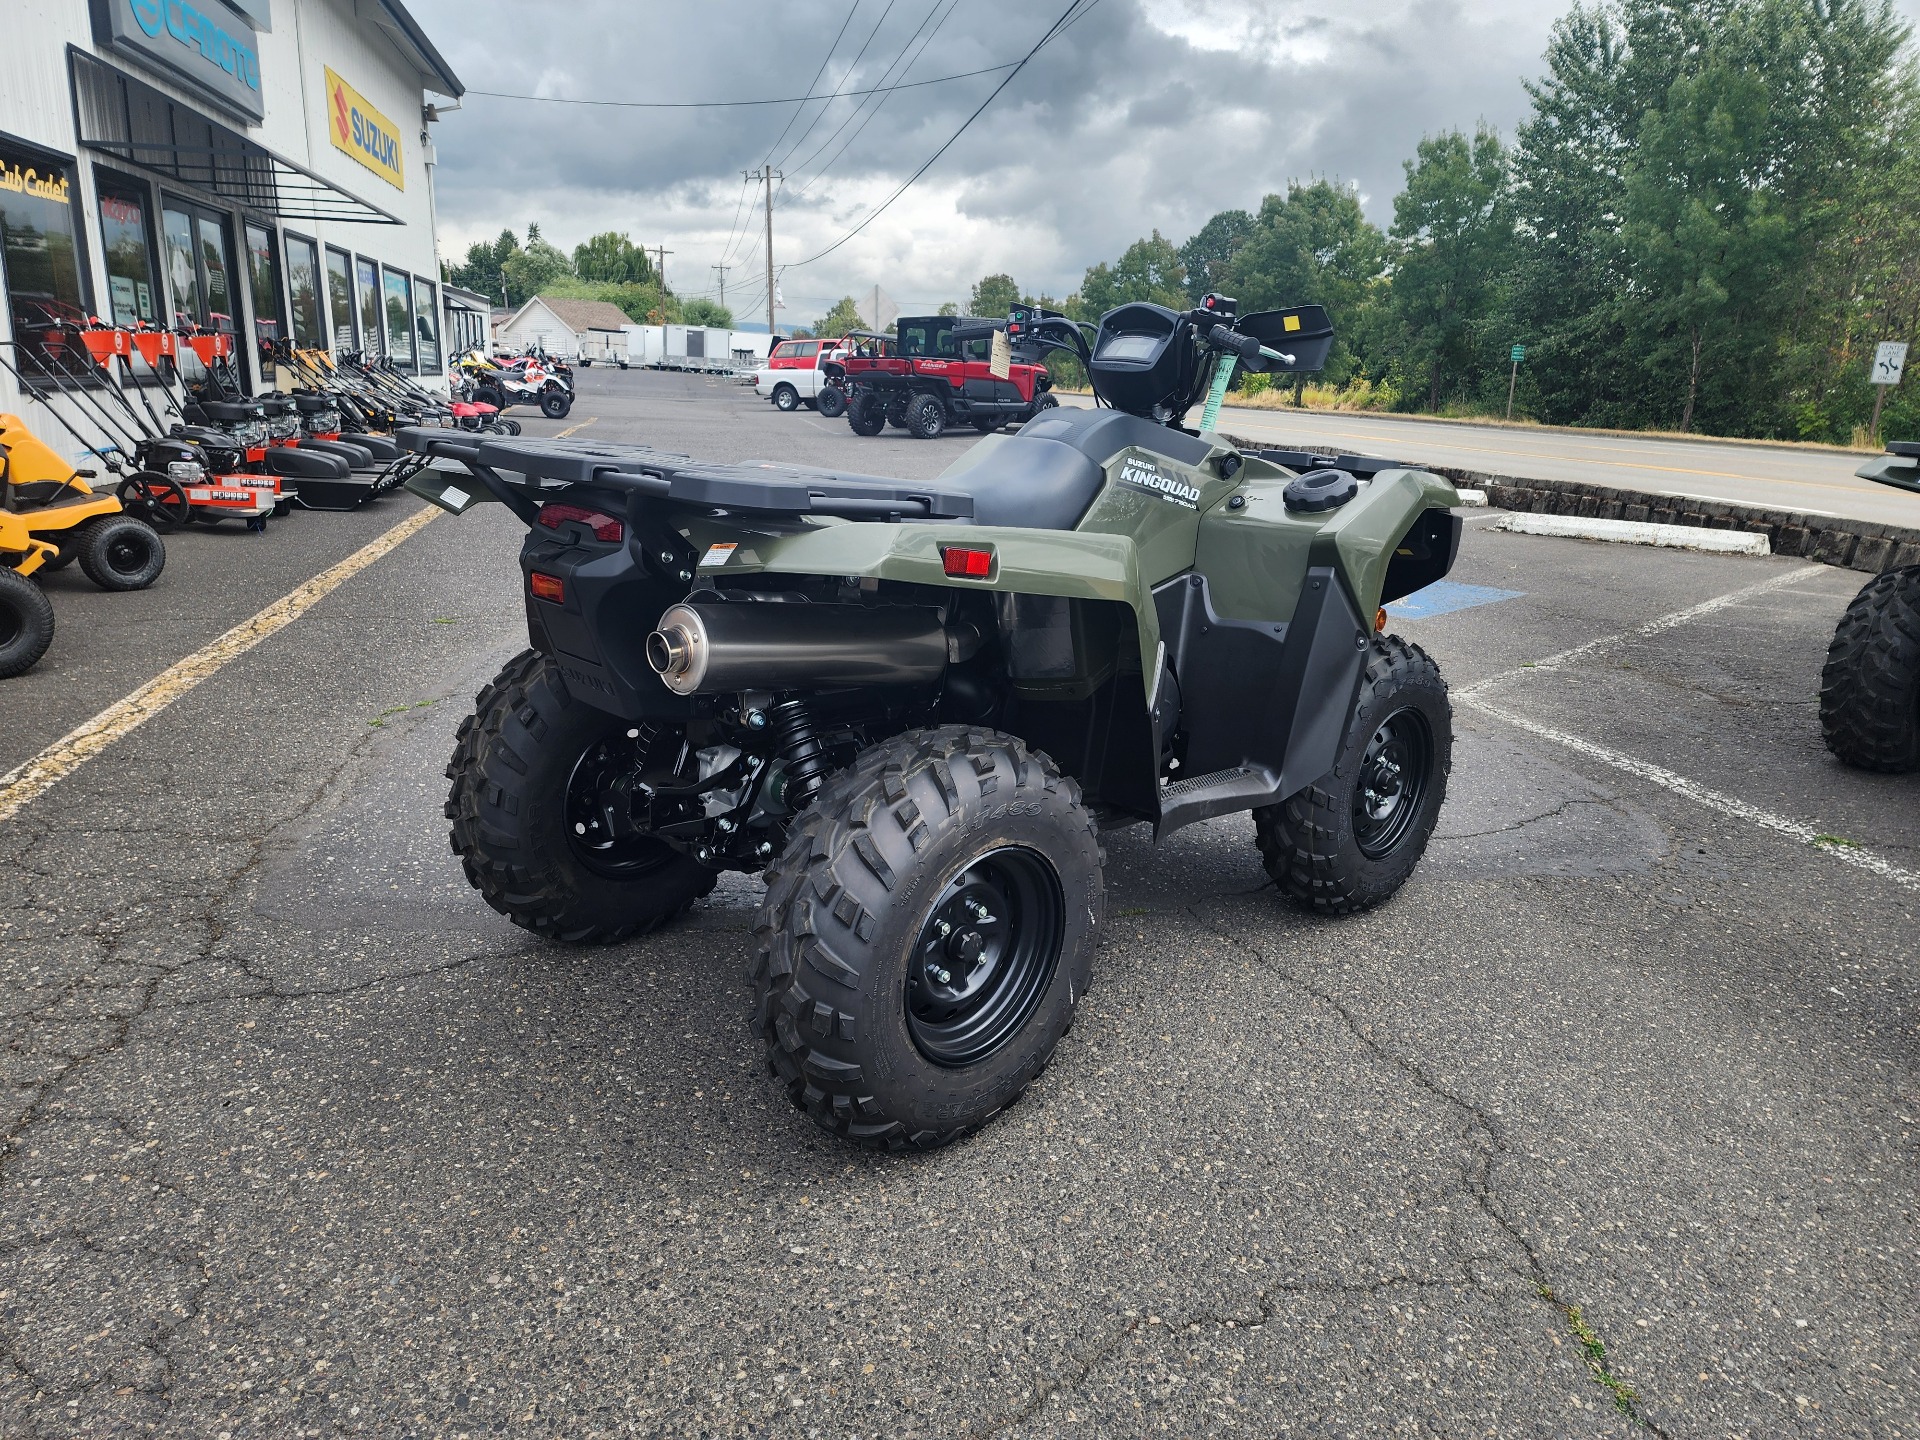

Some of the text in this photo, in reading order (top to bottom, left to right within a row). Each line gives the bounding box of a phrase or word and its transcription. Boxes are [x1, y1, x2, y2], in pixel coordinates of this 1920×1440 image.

[351, 106, 400, 174] SUZUKI
[24, 168, 69, 204] Cadet
[1127, 457, 1156, 472] SUZUKI
[1120, 466, 1201, 502] KINGQUAD
